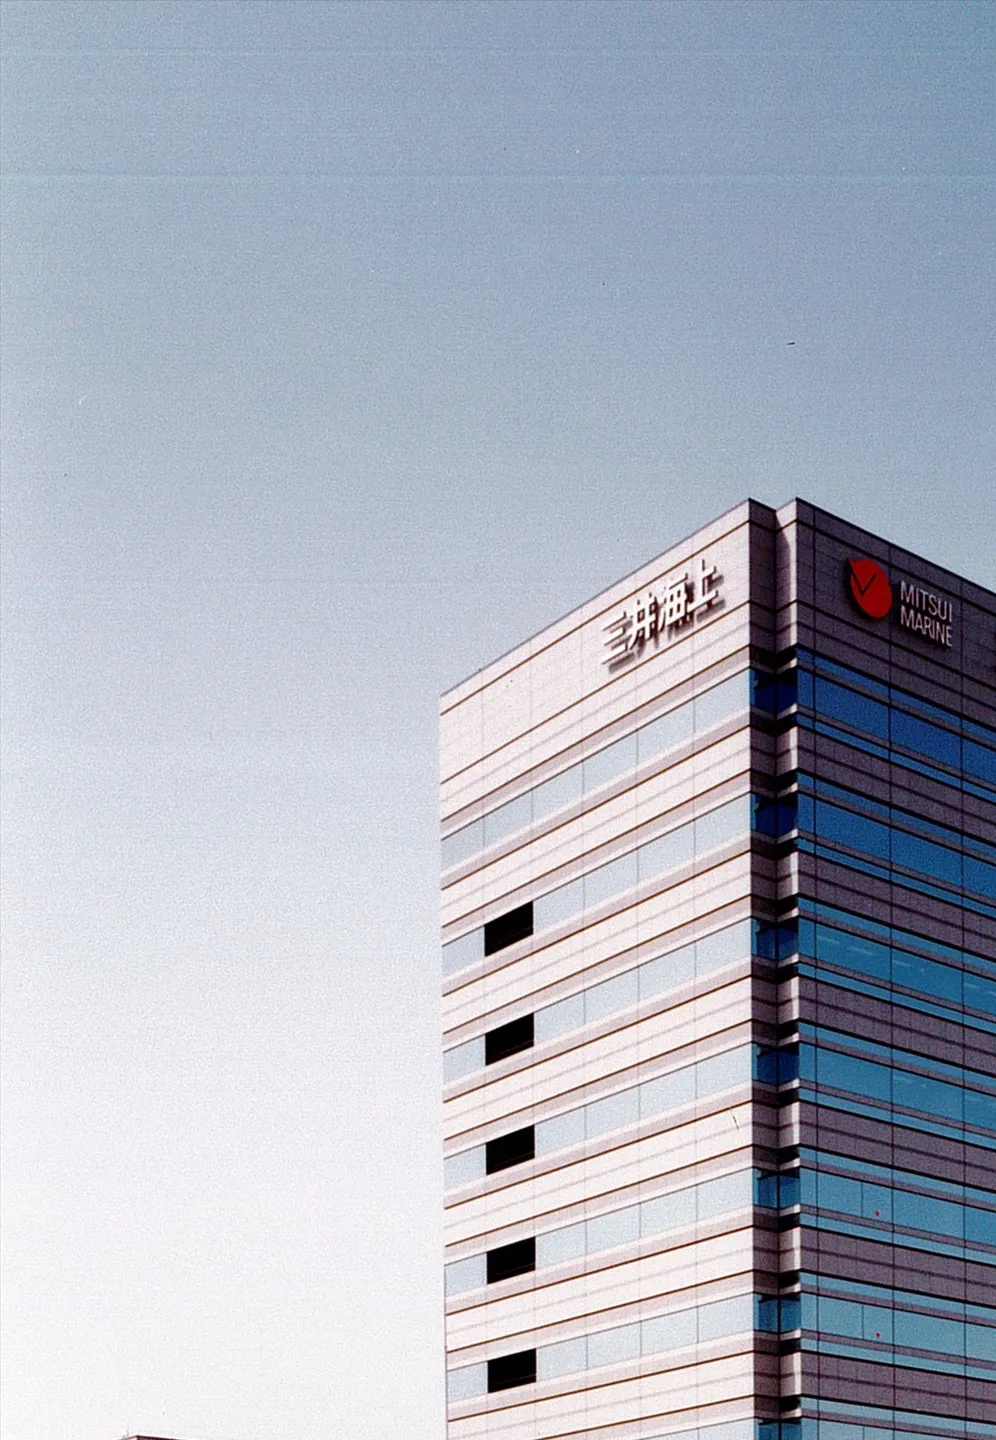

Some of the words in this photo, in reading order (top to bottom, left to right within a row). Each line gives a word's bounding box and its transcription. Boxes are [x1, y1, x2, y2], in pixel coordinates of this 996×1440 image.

[602, 559, 719, 665] 三井海上
[900, 580, 952, 623] MITSUI
[900, 605, 953, 647] MARINE
